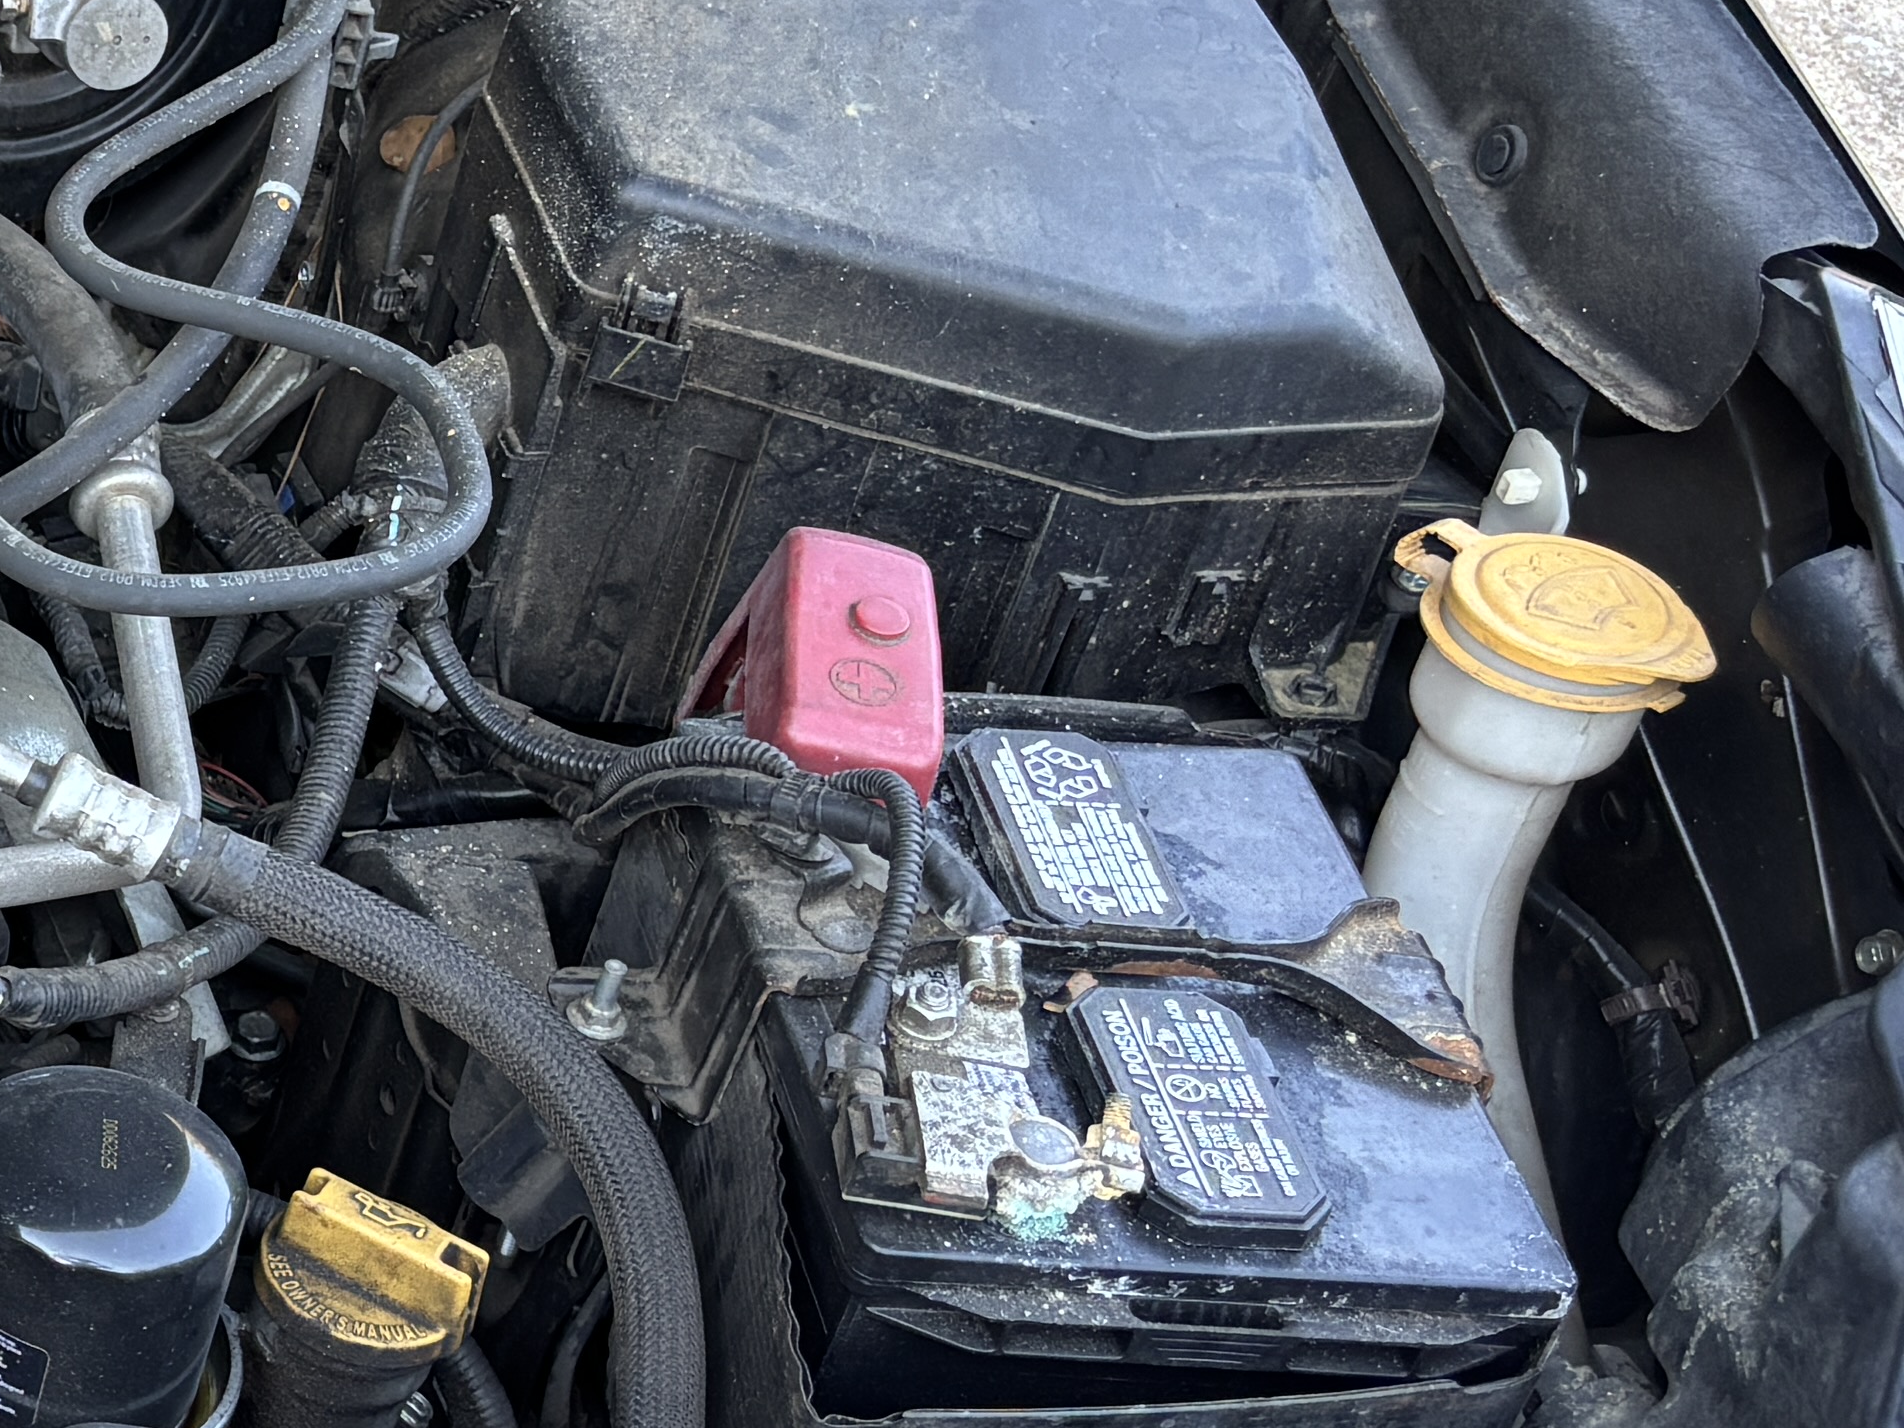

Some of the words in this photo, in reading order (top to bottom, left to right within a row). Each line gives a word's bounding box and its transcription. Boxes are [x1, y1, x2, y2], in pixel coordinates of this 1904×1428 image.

[1101, 1008, 1151, 1076] POISON
[1206, 1082, 1225, 1100] NO
[1140, 1091, 1194, 1169] DANGER
[1186, 1115, 1213, 1149] SHIELD
[1206, 1124, 1229, 1149] EYES
[1219, 1122, 1256, 1173] EXPLOSIVE
[1245, 1142, 1271, 1173] GASES
[268, 1252, 294, 1278] SEE
[281, 1279, 349, 1331] OWNER'S
[352, 1322, 428, 1343] MANUAL
